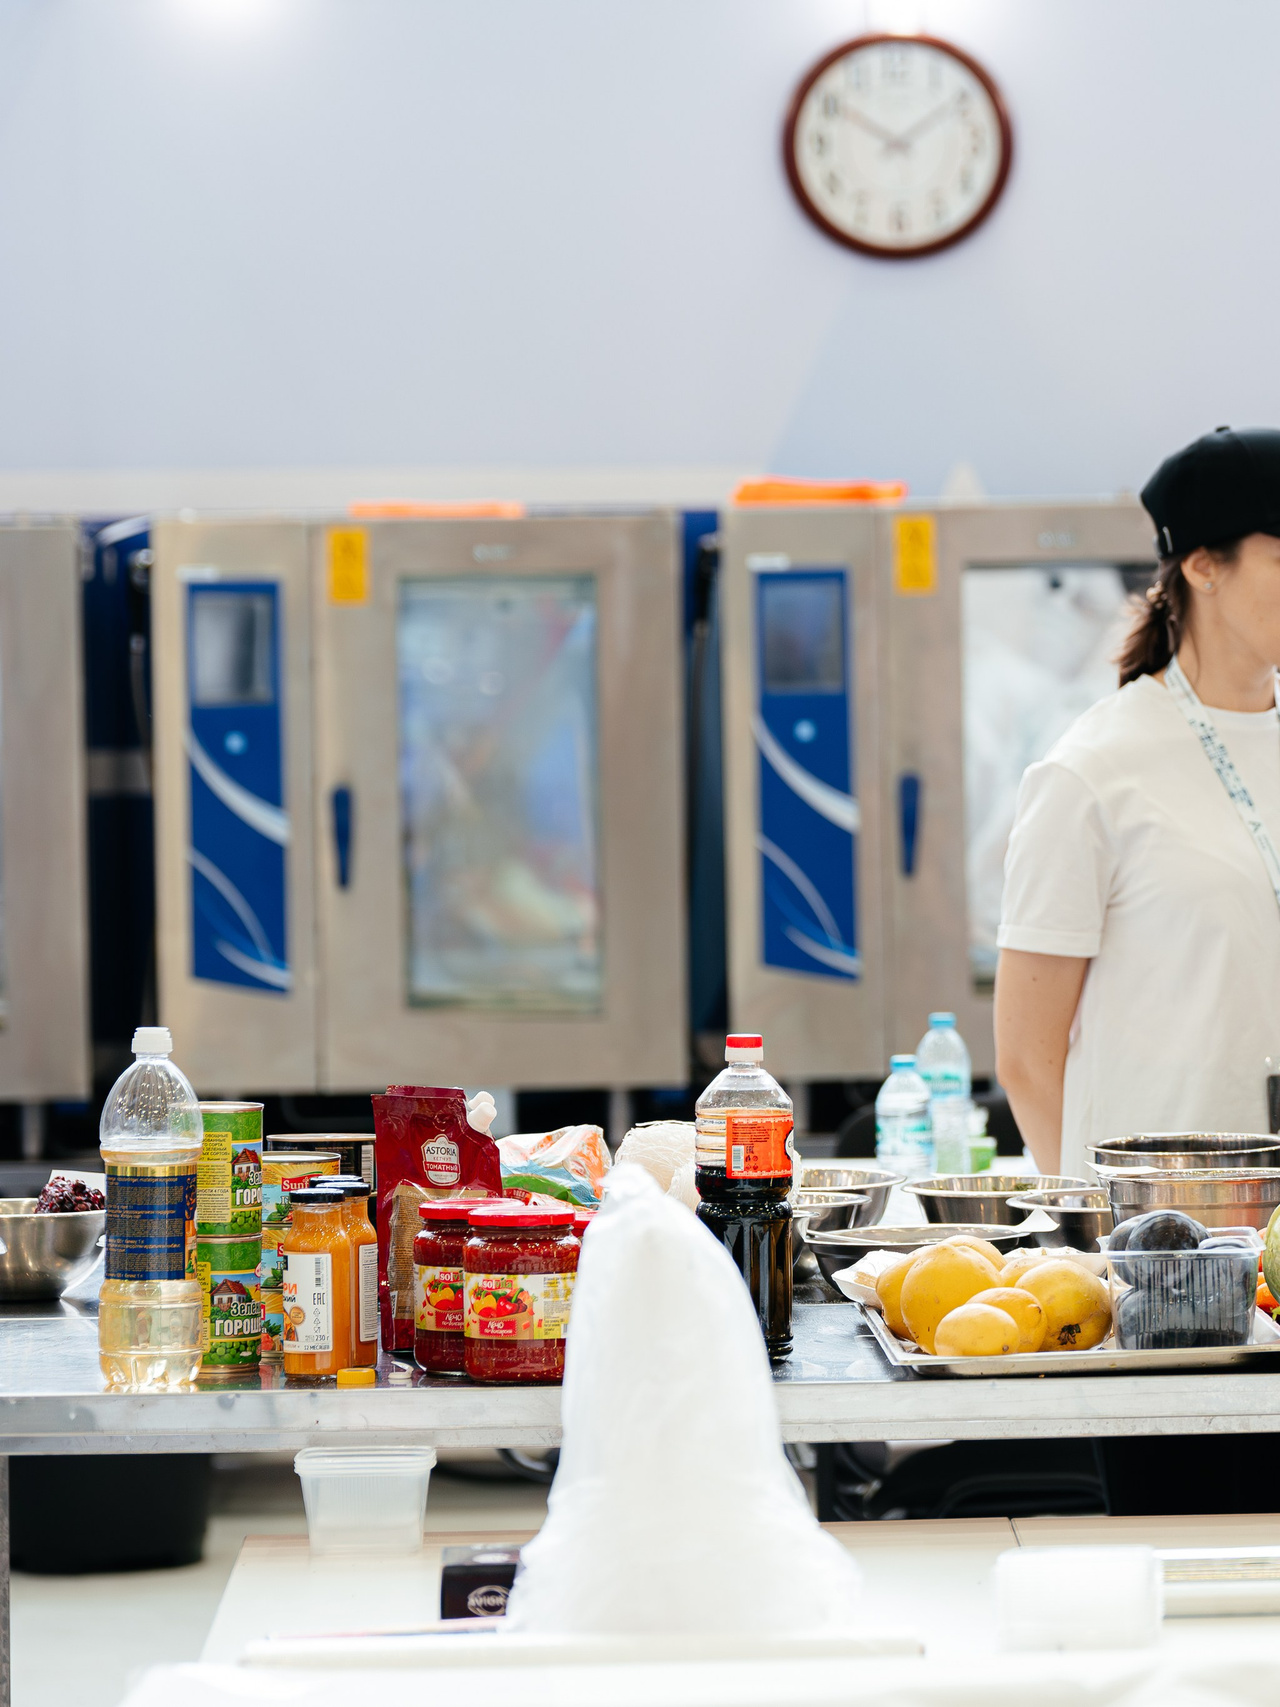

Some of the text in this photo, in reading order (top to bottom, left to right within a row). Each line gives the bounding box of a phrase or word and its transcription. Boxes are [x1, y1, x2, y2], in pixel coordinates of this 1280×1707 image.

[426, 1146, 457, 1156] ASTORIA
[426, 1163, 458, 1172] ТОМАТНЫЙ
[282, 1178, 309, 1190] Sunf
[235, 1187, 262, 1206] ГОРО
[440, 1271, 464, 1282] solvi
[482, 1278, 512, 1289] solvita
[231, 1300, 261, 1316] Зелён
[215, 1317, 261, 1336] ГОРОШ
